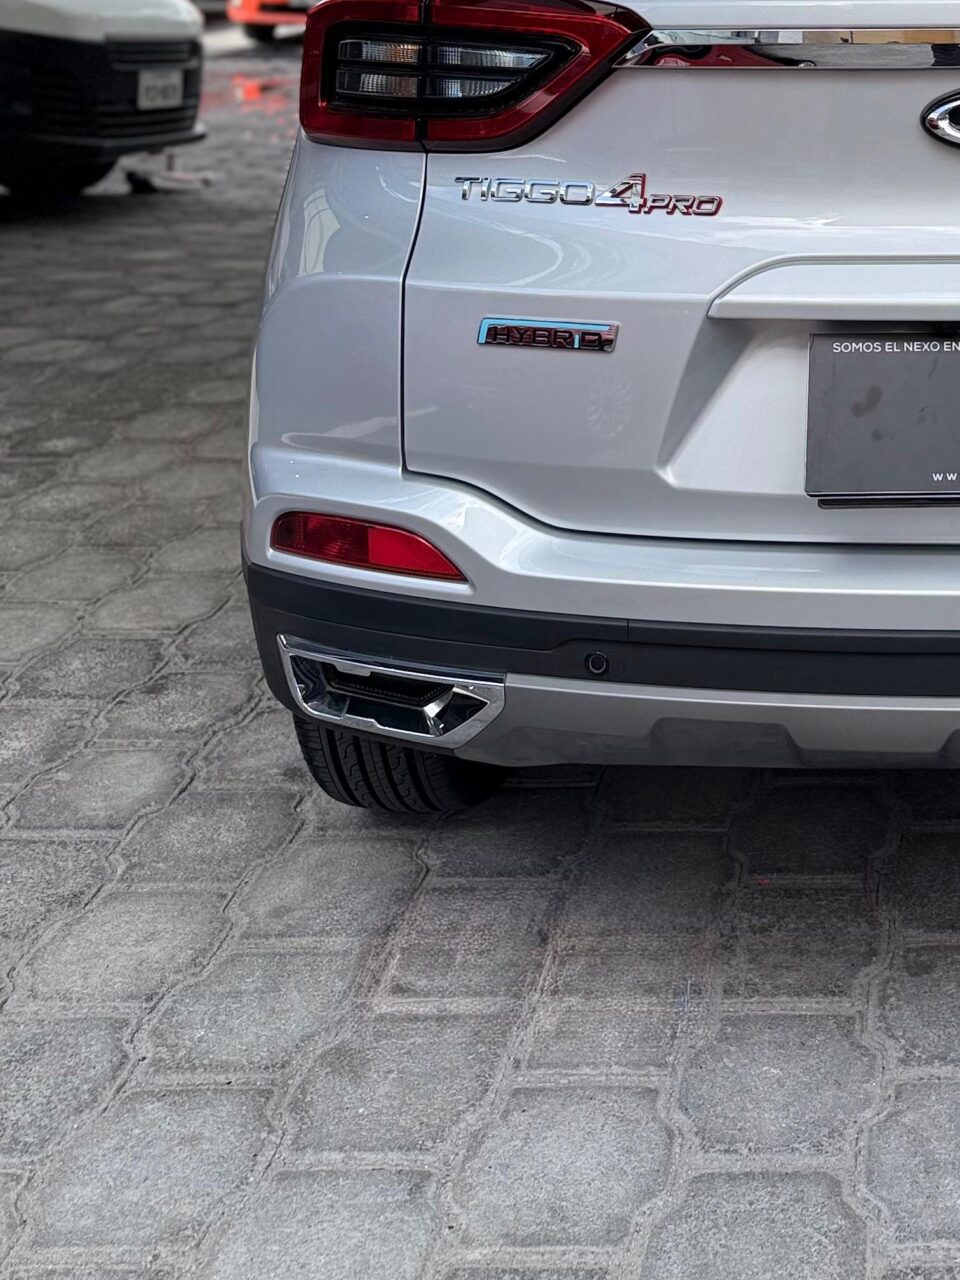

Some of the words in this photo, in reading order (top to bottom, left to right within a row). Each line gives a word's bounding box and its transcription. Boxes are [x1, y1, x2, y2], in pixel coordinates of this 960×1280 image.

[489, 326, 604, 350] HYBRID
[832, 342, 882, 353] SOMOS
[885, 342, 900, 352] EL
[903, 342, 940, 352] NEXO
